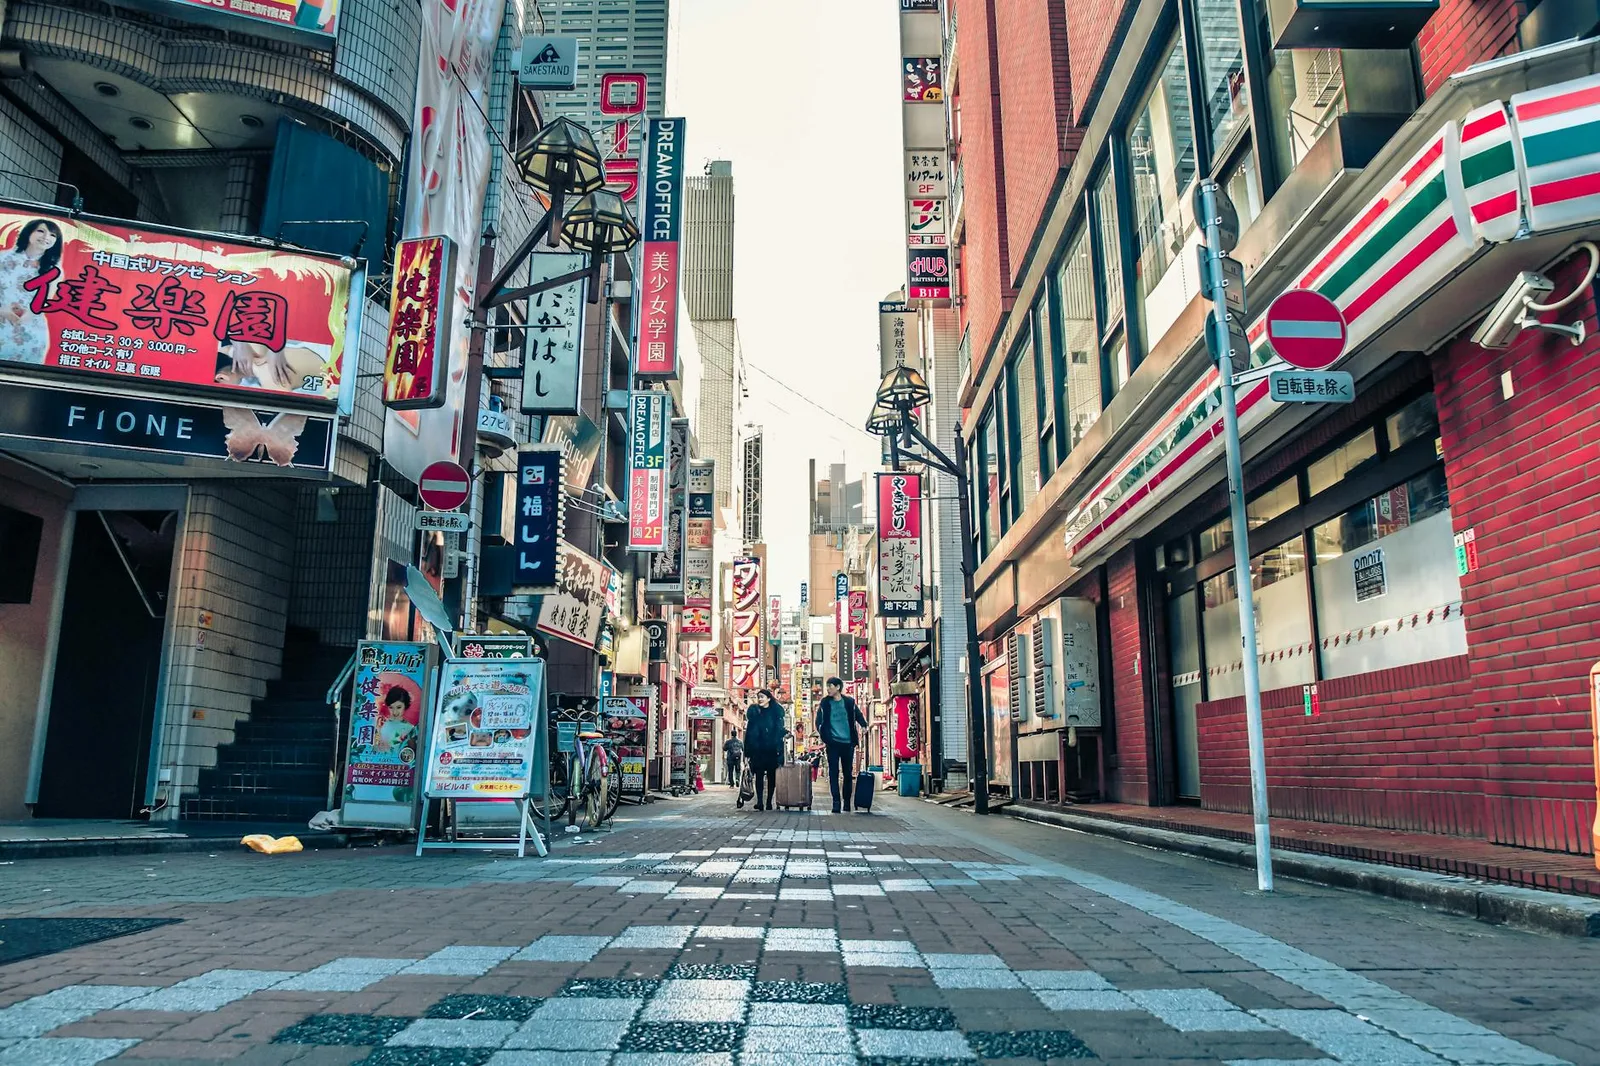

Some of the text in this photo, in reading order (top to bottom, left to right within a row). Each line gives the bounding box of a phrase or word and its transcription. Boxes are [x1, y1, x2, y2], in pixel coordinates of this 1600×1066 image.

[230, 0, 292, 21] 西武新宿店
[524, 65, 570, 76] SAKESTAND
[926, 90, 940, 99] 4F
[912, 155, 939, 167] 喫茶室
[908, 170, 944, 182] ルノアール
[919, 184, 934, 193] 2F
[92, 251, 258, 286] 中国式リラクゼーション
[909, 257, 948, 277] HUB
[919, 288, 940, 297] B1F
[24, 265, 288, 351] 健楽園
[648, 252, 670, 362] 美少女学園
[61, 329, 114, 345] お試しコース
[60, 342, 113, 358] その他コース
[59, 354, 161, 377] 指圧 オイル 足裏 仮眠
[302, 376, 322, 391] 2F
[1276, 378, 1348, 396] 自転車を除く
[67, 405, 194, 440] FIONE
[482, 415, 510, 432] 27ビル
[646, 455, 664, 468] 3F
[649, 475, 658, 517] 制服専門店
[892, 477, 906, 530] やきとり
[633, 476, 643, 538] 美少女学園
[420, 515, 463, 529] 自転車を除く
[520, 495, 542, 570] 福しん
[644, 525, 662, 539] 2F
[889, 541, 907, 593] 博多流
[1354, 549, 1382, 571] omni7
[884, 601, 917, 611] 地下2階
[733, 562, 760, 686] ワンフロア
[771, 597, 780, 639] カラオケ
[357, 675, 382, 746] 健楽園
[635, 699, 646, 707] B1
[435, 783, 470, 792] 当ビル4F
